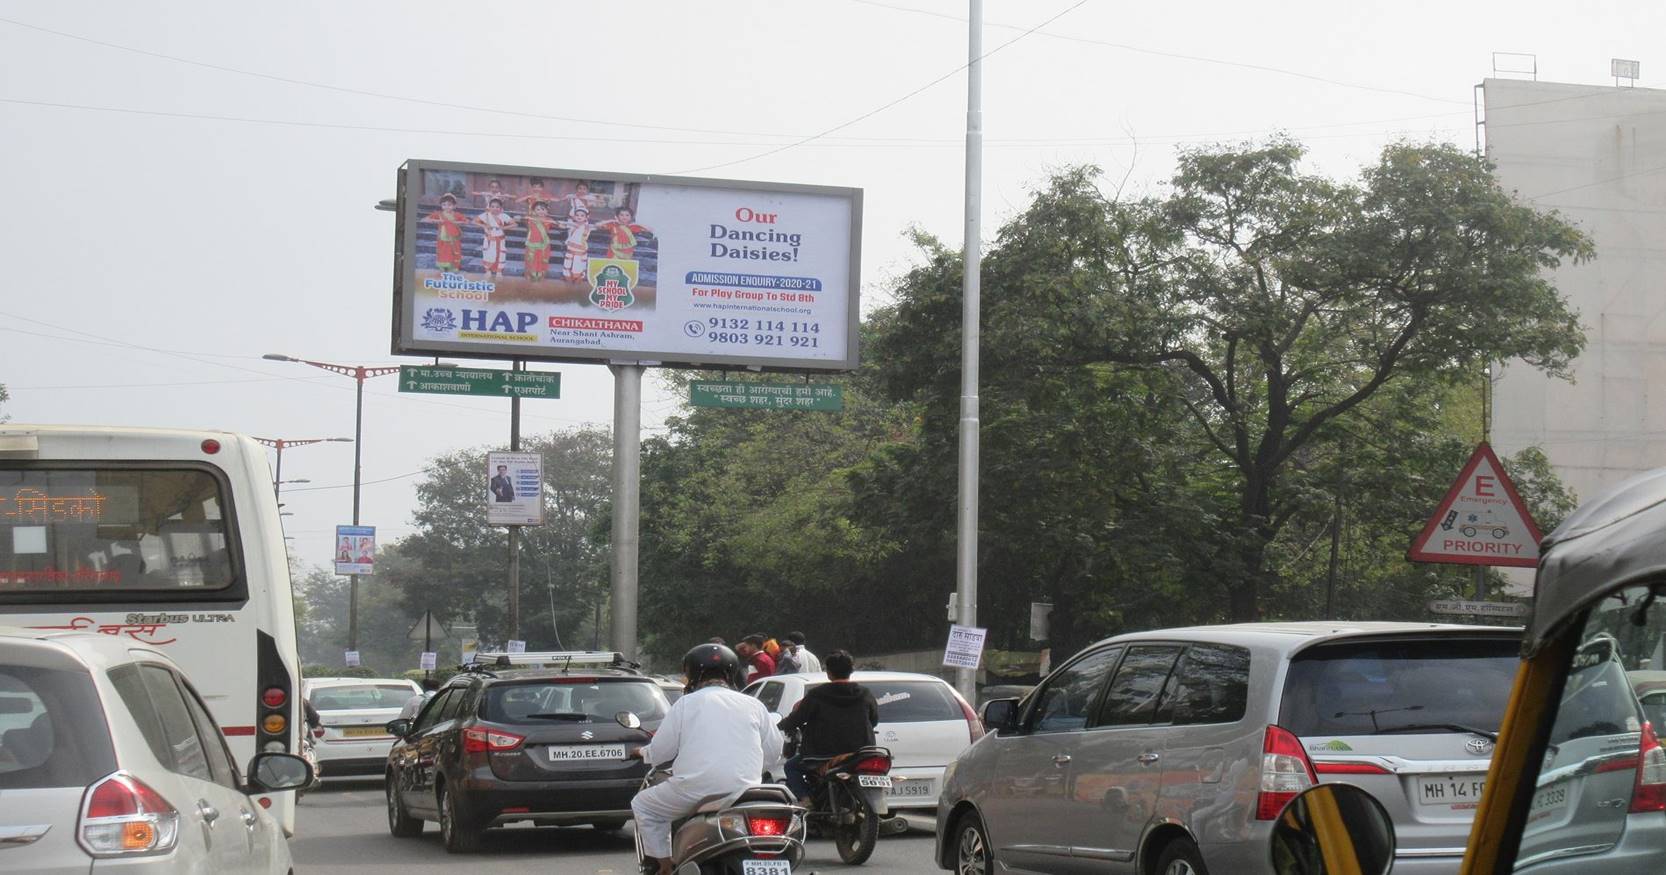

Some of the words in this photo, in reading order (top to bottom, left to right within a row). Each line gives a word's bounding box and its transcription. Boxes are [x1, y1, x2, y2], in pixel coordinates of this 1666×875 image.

[736, 207, 778, 224] Our
[710, 224, 801, 247] Dancing
[711, 242, 799, 262] Daisies!
[443, 272, 464, 281] The
[692, 273, 739, 285] ADMISSION
[425, 279, 496, 292] Futuristic
[606, 280, 620, 288] MY
[441, 289, 489, 300] School
[597, 287, 628, 296] SCHOOL
[692, 288, 709, 297] For
[711, 289, 732, 300] Play
[735, 291, 764, 301] Group
[766, 292, 778, 301] To
[780, 293, 797, 302] Std
[798, 294, 815, 303] 8th
[600, 301, 625, 309] PRIDE
[694, 302, 812, 315] www.hapinternationalschool.org
[462, 309, 539, 333] HAP
[553, 319, 641, 332] CHIKALTHANA
[709, 317, 750, 330] 9132
[757, 320, 786, 332] 114
[792, 322, 821, 334] 114
[461, 332, 501, 340] INTERNATIONAL
[550, 330, 570, 338] Near
[573, 331, 597, 341] Shani
[709, 332, 750, 345] 9803
[755, 334, 784, 346] 921
[790, 336, 819, 348] 921
[1476, 476, 1495, 497] E
[1460, 496, 1508, 506] Emergency
[1443, 540, 1523, 555] PRIORITY
[125, 613, 190, 624] Starbus
[192, 614, 235, 623] ULTRA
[553, 749, 623, 760] MH.20.EE.6706
[1424, 783, 1445, 798] MH
[1450, 782, 1467, 797] 14
